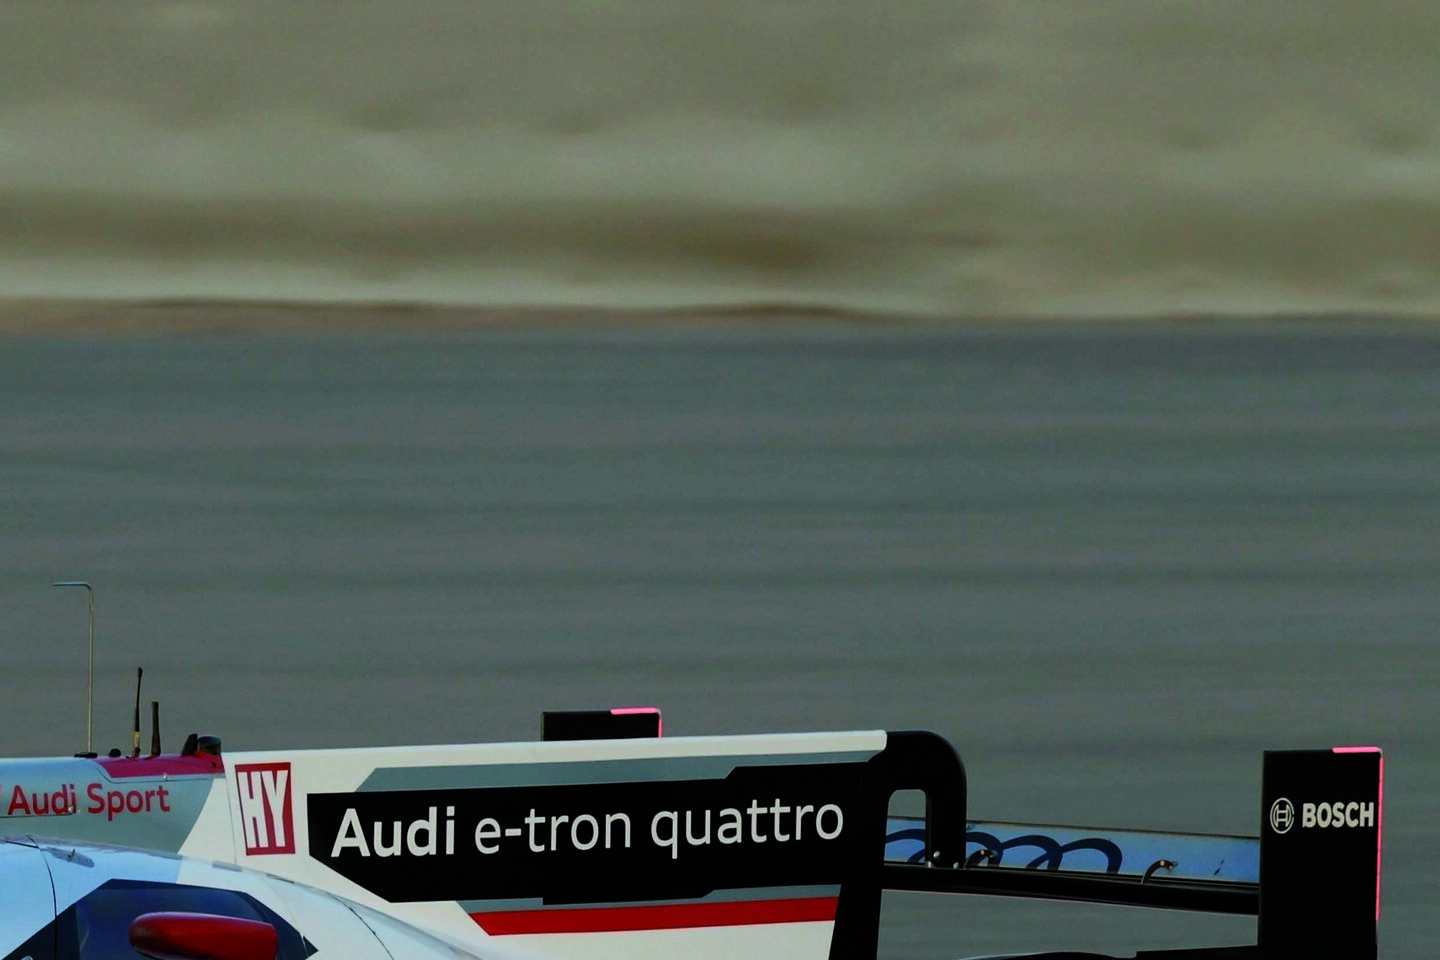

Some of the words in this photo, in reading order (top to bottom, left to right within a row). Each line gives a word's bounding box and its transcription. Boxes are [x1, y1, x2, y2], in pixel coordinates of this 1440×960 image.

[7, 784, 77, 816] Audi
[87, 782, 171, 822] Sport
[239, 769, 289, 849] HY
[1301, 801, 1375, 829] BOSCH
[330, 806, 456, 859] Audi
[474, 808, 632, 855] e-tron
[650, 797, 845, 860] quattro
